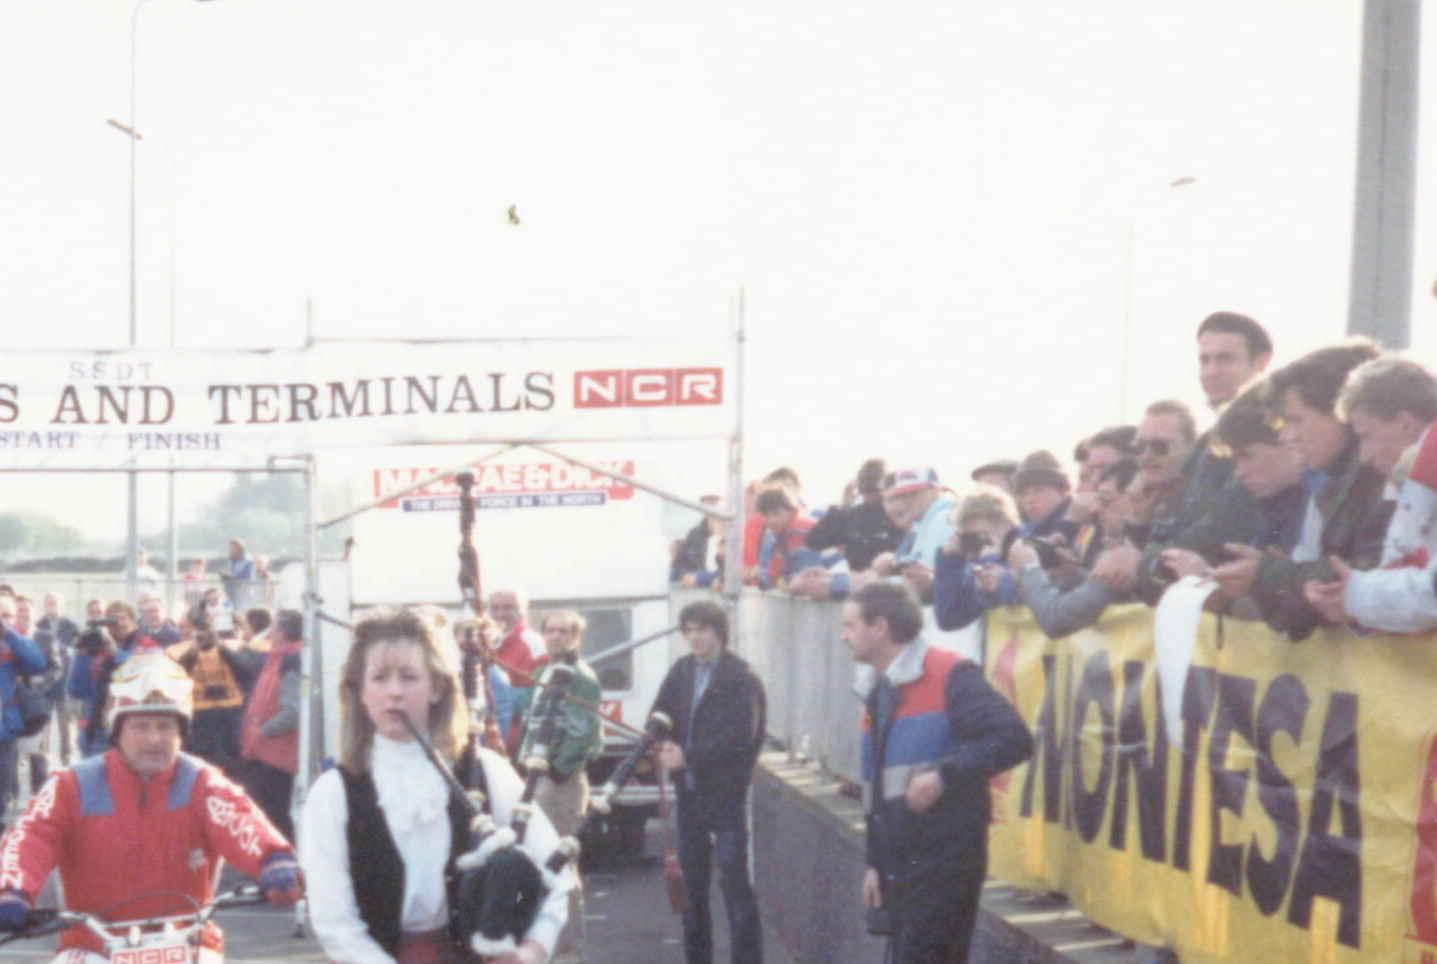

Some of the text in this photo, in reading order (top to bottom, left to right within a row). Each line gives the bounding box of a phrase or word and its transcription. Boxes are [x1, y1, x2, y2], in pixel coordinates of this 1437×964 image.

[50, 384, 175, 425] AND
[208, 371, 556, 426] TERMINALS
[577, 370, 721, 405] NCR
[127, 432, 221, 450] FINISH
[1019, 650, 1361, 950] MONTESA
